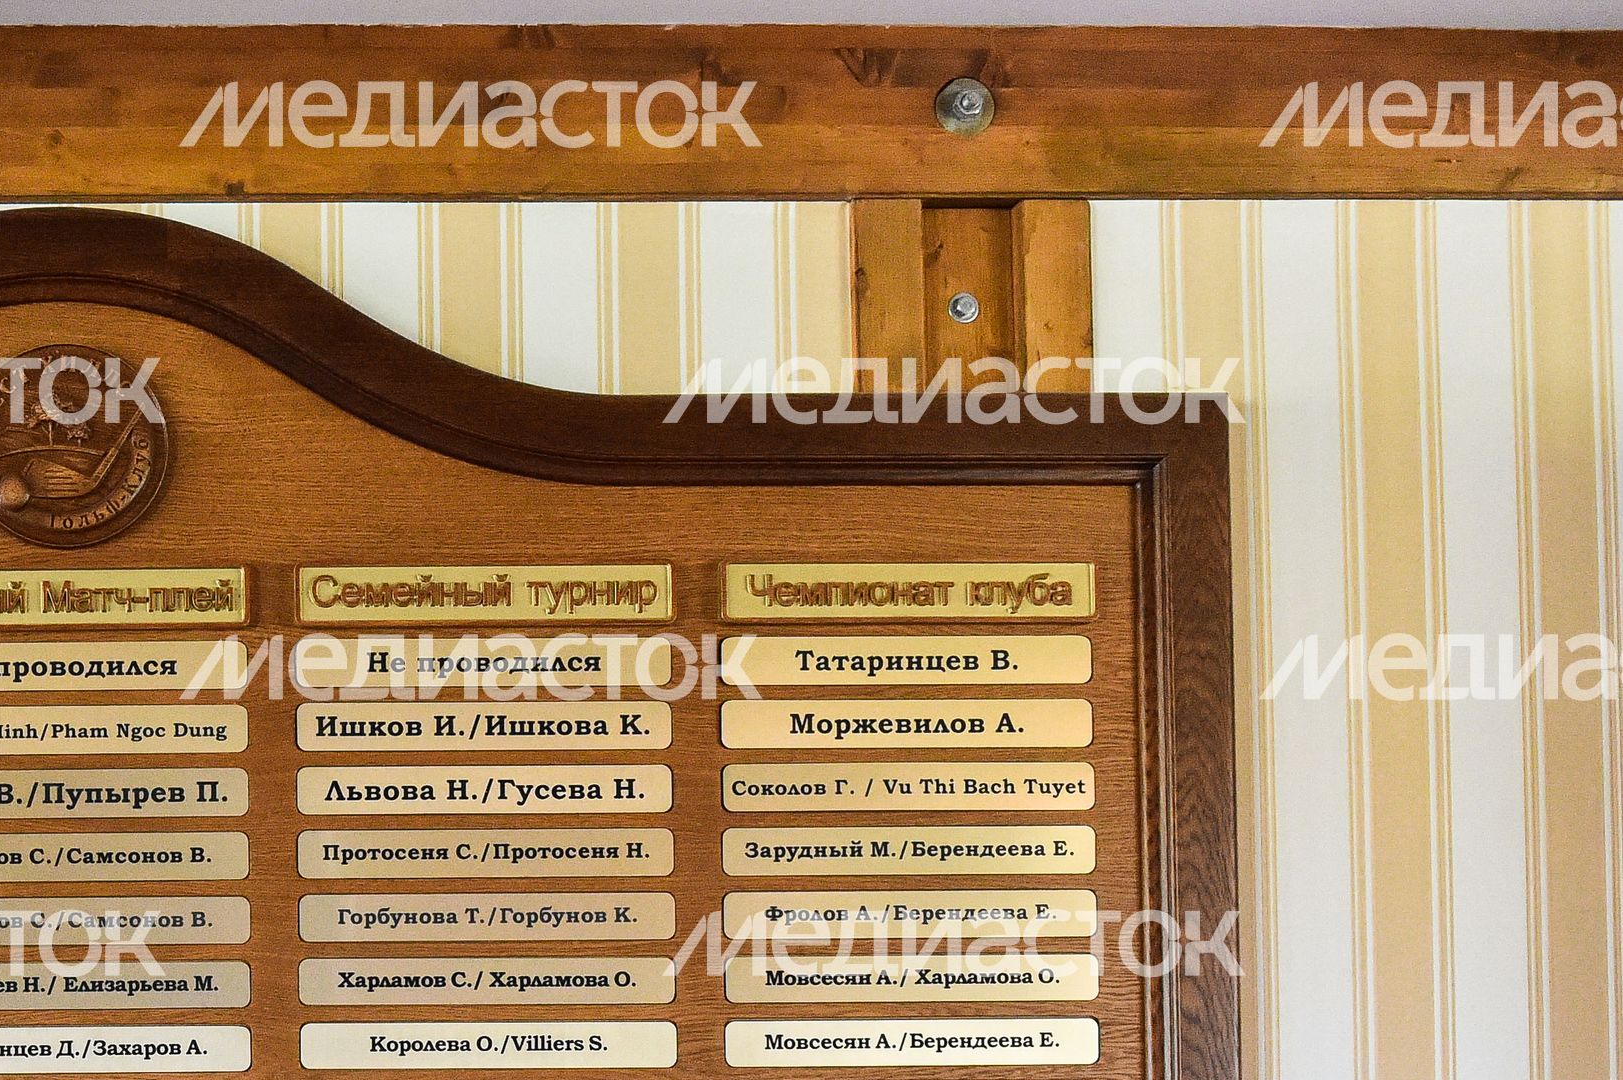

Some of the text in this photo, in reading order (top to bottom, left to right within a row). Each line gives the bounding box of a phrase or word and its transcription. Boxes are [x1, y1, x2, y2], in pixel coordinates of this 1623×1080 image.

[41, 579, 236, 615] Матч-плей
[311, 574, 660, 615] Семейный турнир
[745, 572, 1073, 615] Чемпионат клуба
[366, 651, 602, 679] Не проводился
[794, 649, 1019, 678] Татаринцев В.
[115, 723, 166, 743] Ngoc
[172, 722, 228, 742] Dung
[315, 713, 650, 741] Ишков И./Ишкова К.
[789, 712, 1025, 741] Моржевилов А.
[195, 780, 228, 803] П.
[323, 777, 645, 807] Львова Н./Гусева Н.
[731, 777, 1087, 799] Соколов Г. / Vu Thi Bach Tuyet
[28, 846, 184, 868] С./Самсонов
[189, 846, 212, 863] В.
[322, 842, 650, 866] Протосеня С./Протосеня Н.
[744, 839, 1075, 863] Зарудный М./Берендеева Е.
[190, 911, 213, 929] В.
[337, 905, 638, 930] Горбунова Т./Горбунов К.
[764, 905, 849, 926] Фролов
[1034, 903, 1058, 920] Е.
[62, 976, 190, 997] Елизарьева
[192, 975, 219, 992] М.
[337, 970, 637, 993] Харламов С./ Харламова О.
[764, 969, 873, 987] Мовсесян
[913, 968, 1034, 990] Харламова
[1037, 968, 1060, 984] О.
[55, 1039, 182, 1061] Д./Захаров
[185, 1038, 208, 1056] А.
[369, 1034, 608, 1057] Королева О./Villiers S.
[764, 1031, 1060, 1054] Мовсесян А./Берендеева Е.
